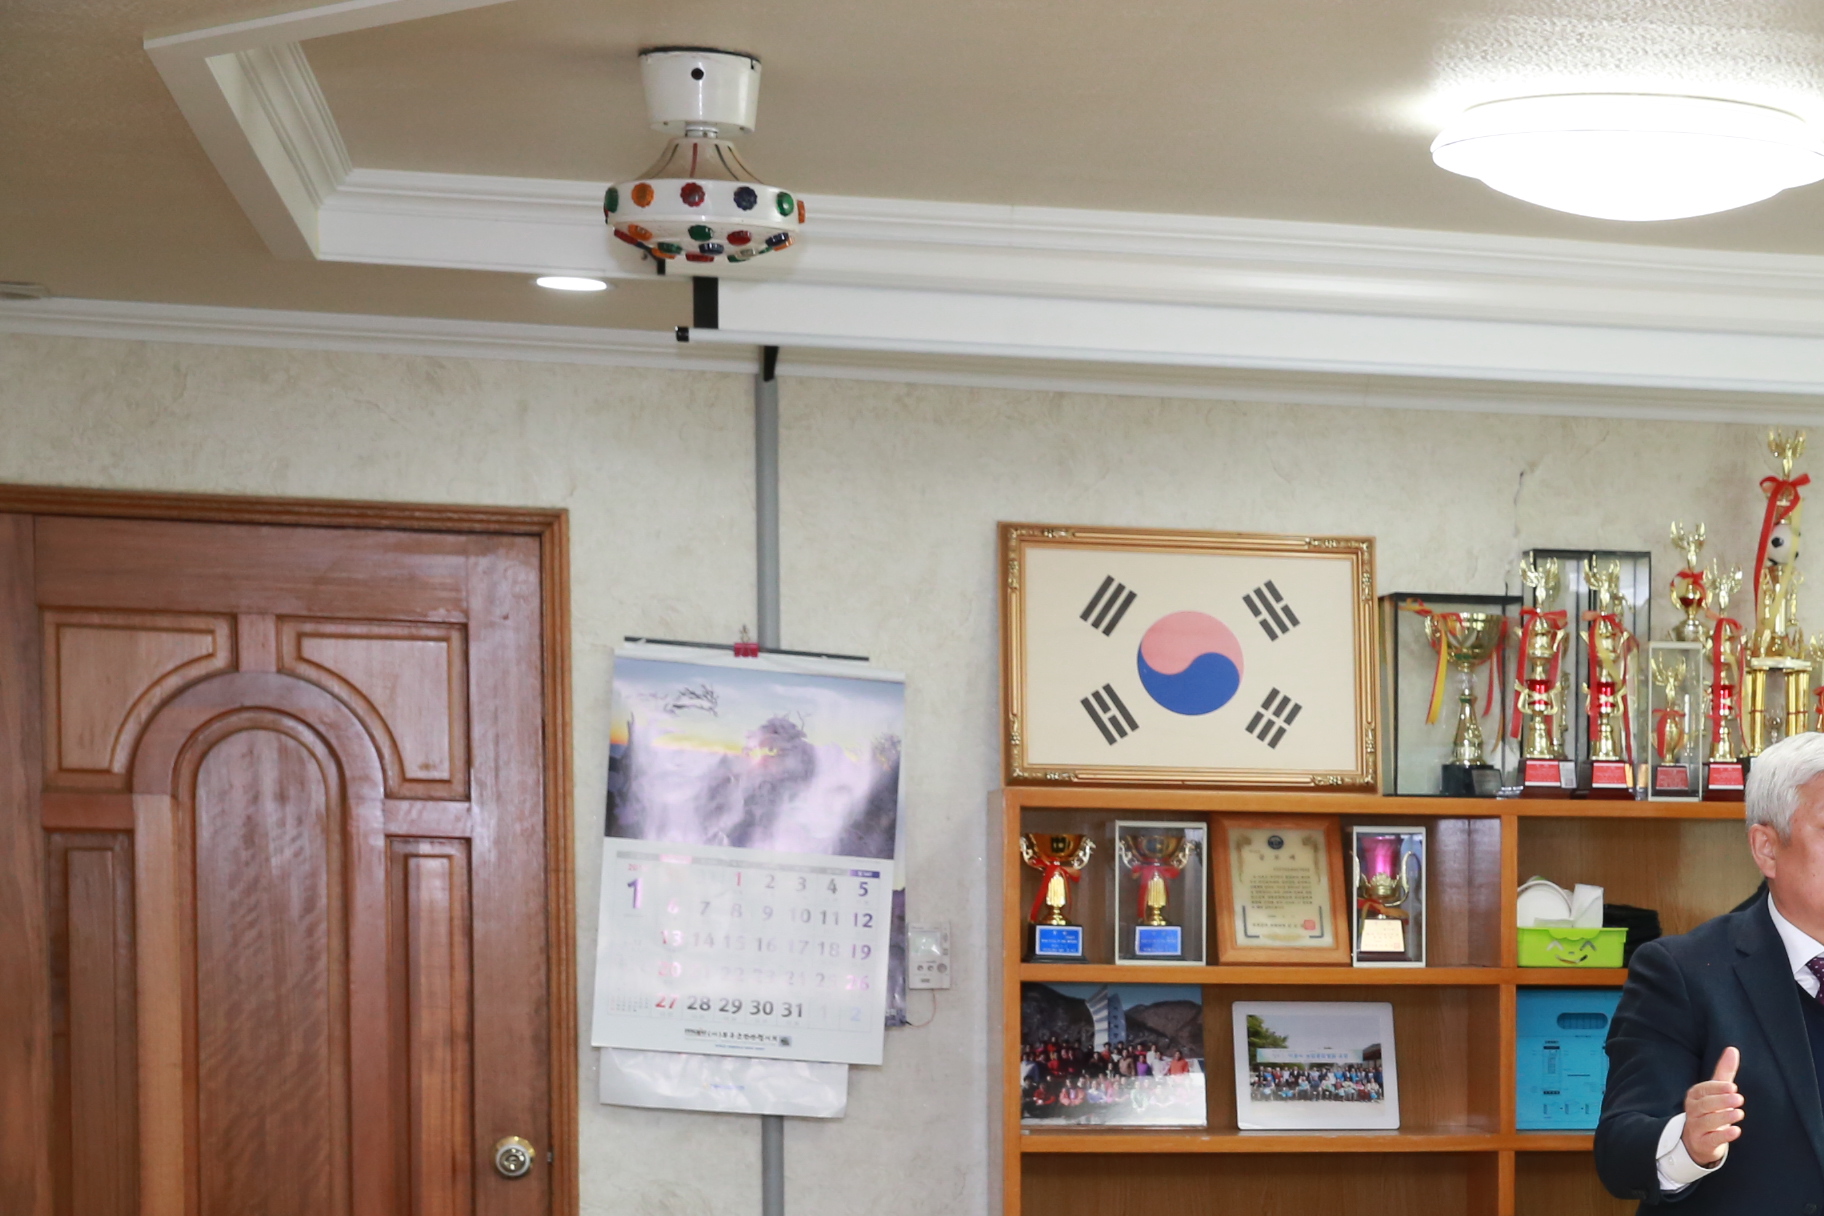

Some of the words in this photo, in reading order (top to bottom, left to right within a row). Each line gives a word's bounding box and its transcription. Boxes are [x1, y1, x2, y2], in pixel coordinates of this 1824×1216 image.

[627, 876, 643, 909] 1
[735, 872, 743, 887] 1
[765, 874, 775, 890] 2
[796, 877, 807, 892] 3
[827, 879, 838, 895] 4
[858, 881, 869, 897] 5
[700, 901, 711, 916] 7
[731, 903, 743, 918] 8
[762, 905, 774, 921] 9
[790, 907, 811, 924] 10
[820, 910, 840, 926] 11
[853, 912, 873, 929] 12
[660, 929, 683, 947] 13
[693, 932, 715, 949] 14
[724, 934, 745, 951] 15
[757, 936, 777, 953] 16
[788, 938, 809, 955] 17
[817, 941, 840, 958] 18
[851, 944, 872, 961] 19
[658, 961, 682, 978] 20
[845, 975, 870, 992] 26
[655, 993, 680, 1010] 27
[686, 995, 712, 1012] 28
[718, 998, 743, 1015] 29
[749, 1000, 774, 1017] 30
[780, 1002, 803, 1019] 31
